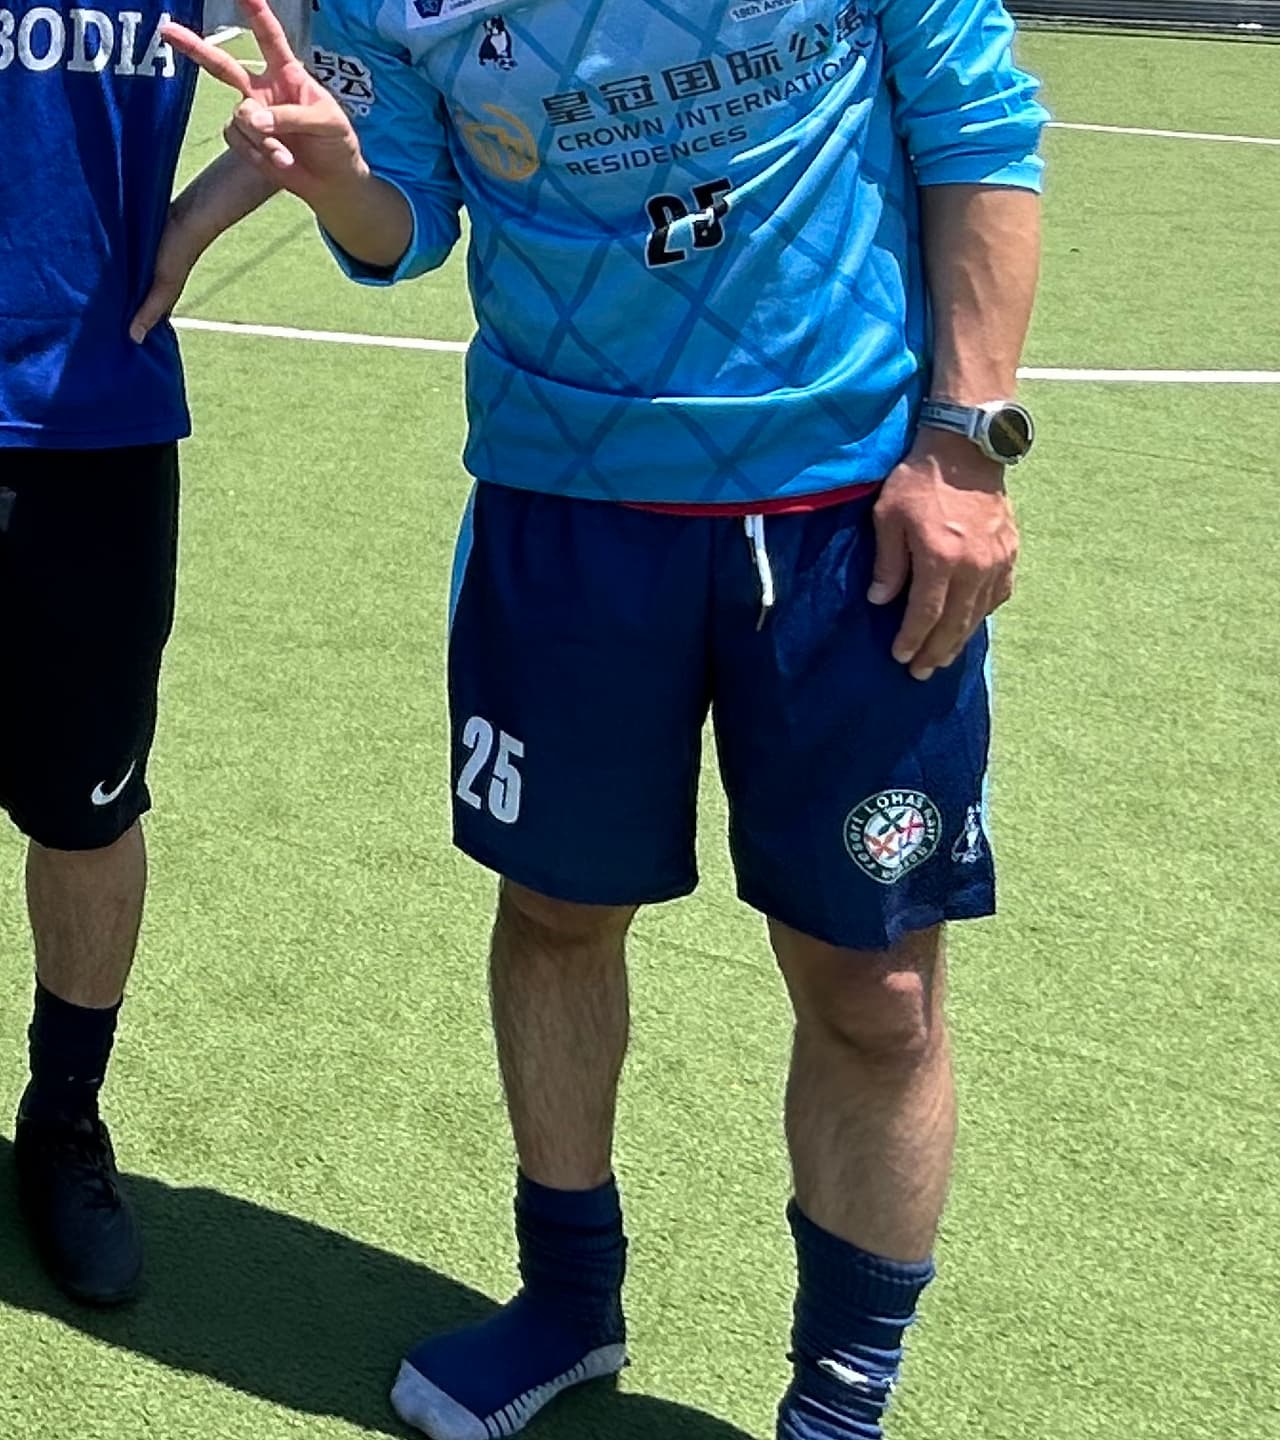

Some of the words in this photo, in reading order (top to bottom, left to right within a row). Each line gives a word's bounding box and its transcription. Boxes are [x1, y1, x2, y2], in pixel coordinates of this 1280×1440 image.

[557, 116, 665, 152] CROWN
[675, 41, 872, 130] INTERNATIO
[565, 124, 747, 176] RESIDENCES
[645, 176, 733, 268] 25
[456, 715, 526, 825] 25
[864, 793, 925, 815] LOHAS
